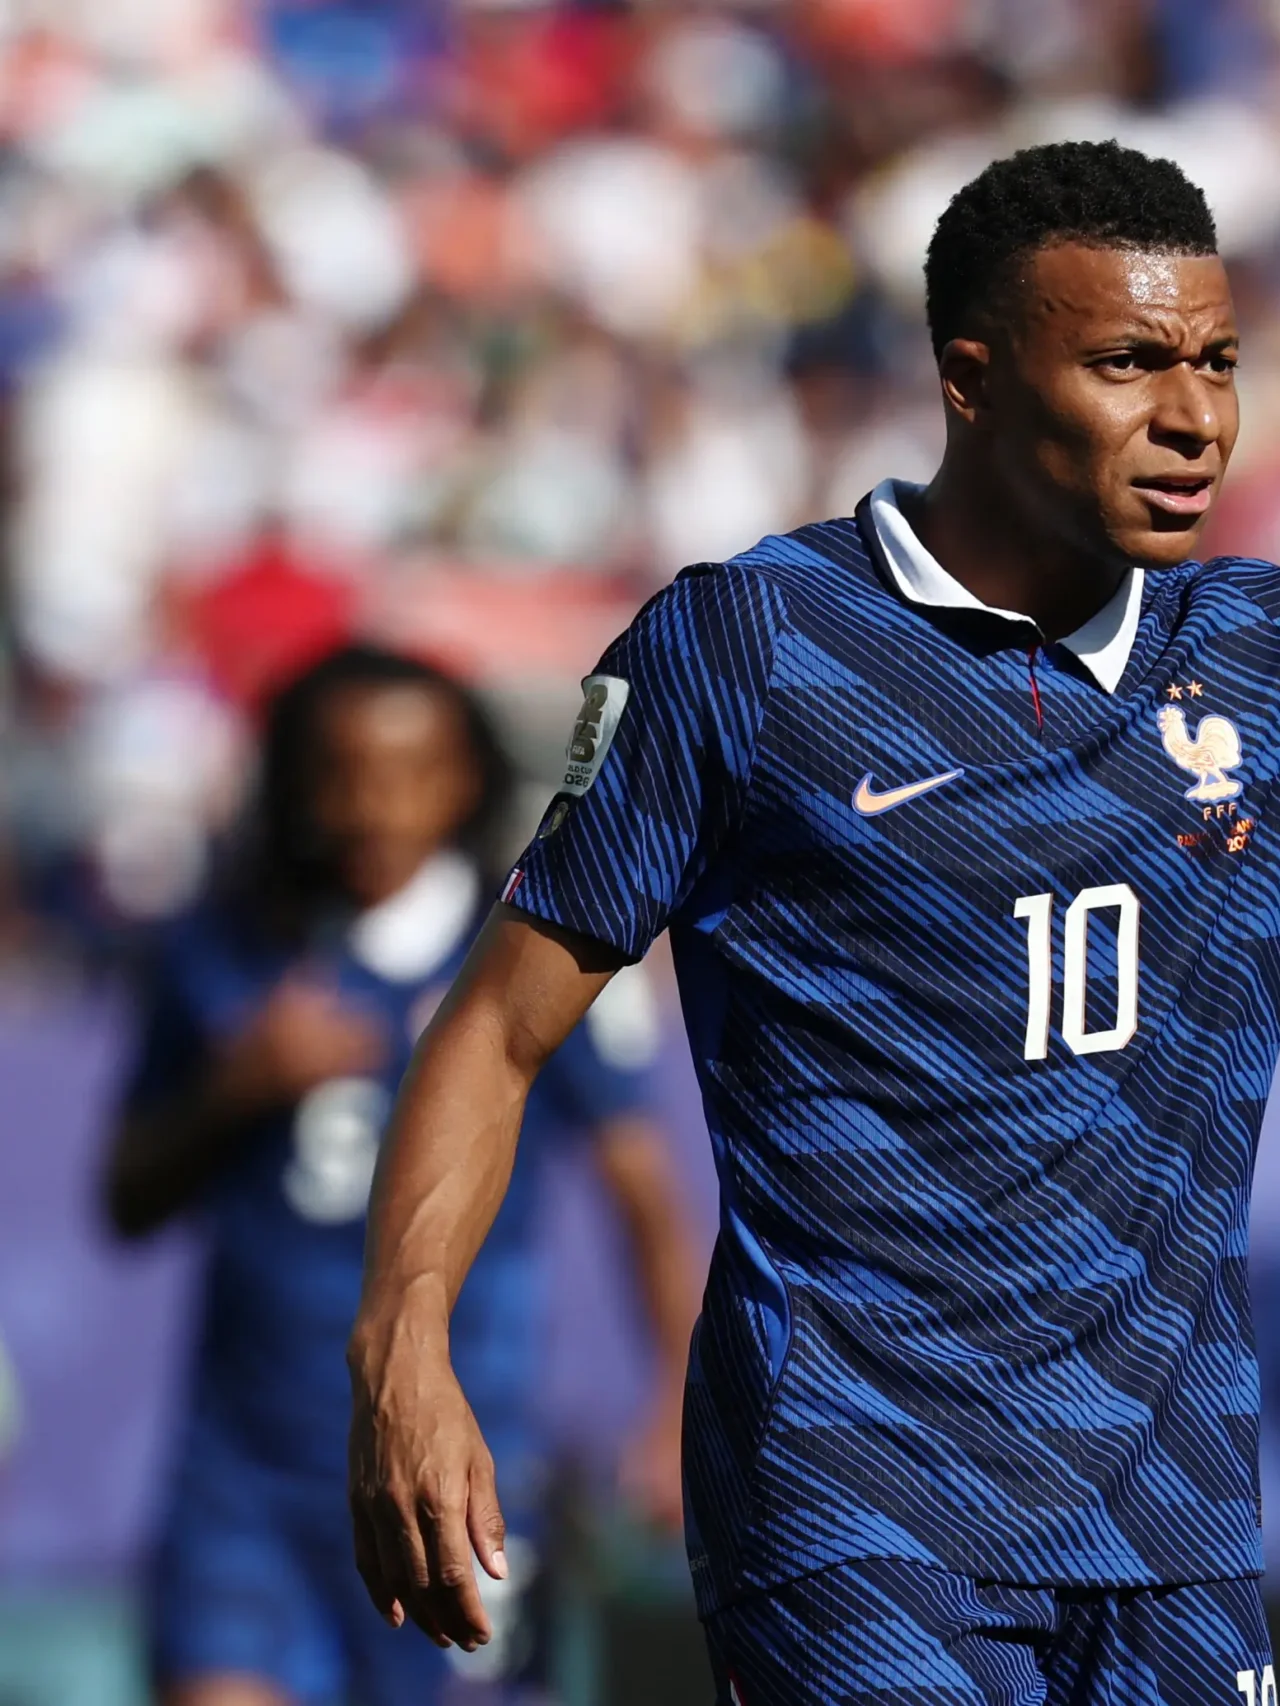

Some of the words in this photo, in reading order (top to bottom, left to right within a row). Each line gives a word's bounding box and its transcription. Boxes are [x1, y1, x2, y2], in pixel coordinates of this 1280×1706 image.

[581, 766, 593, 775] CUP
[563, 773, 590, 788] 026
[1203, 802, 1237, 821] FFF
[1014, 883, 1140, 1060] 10
